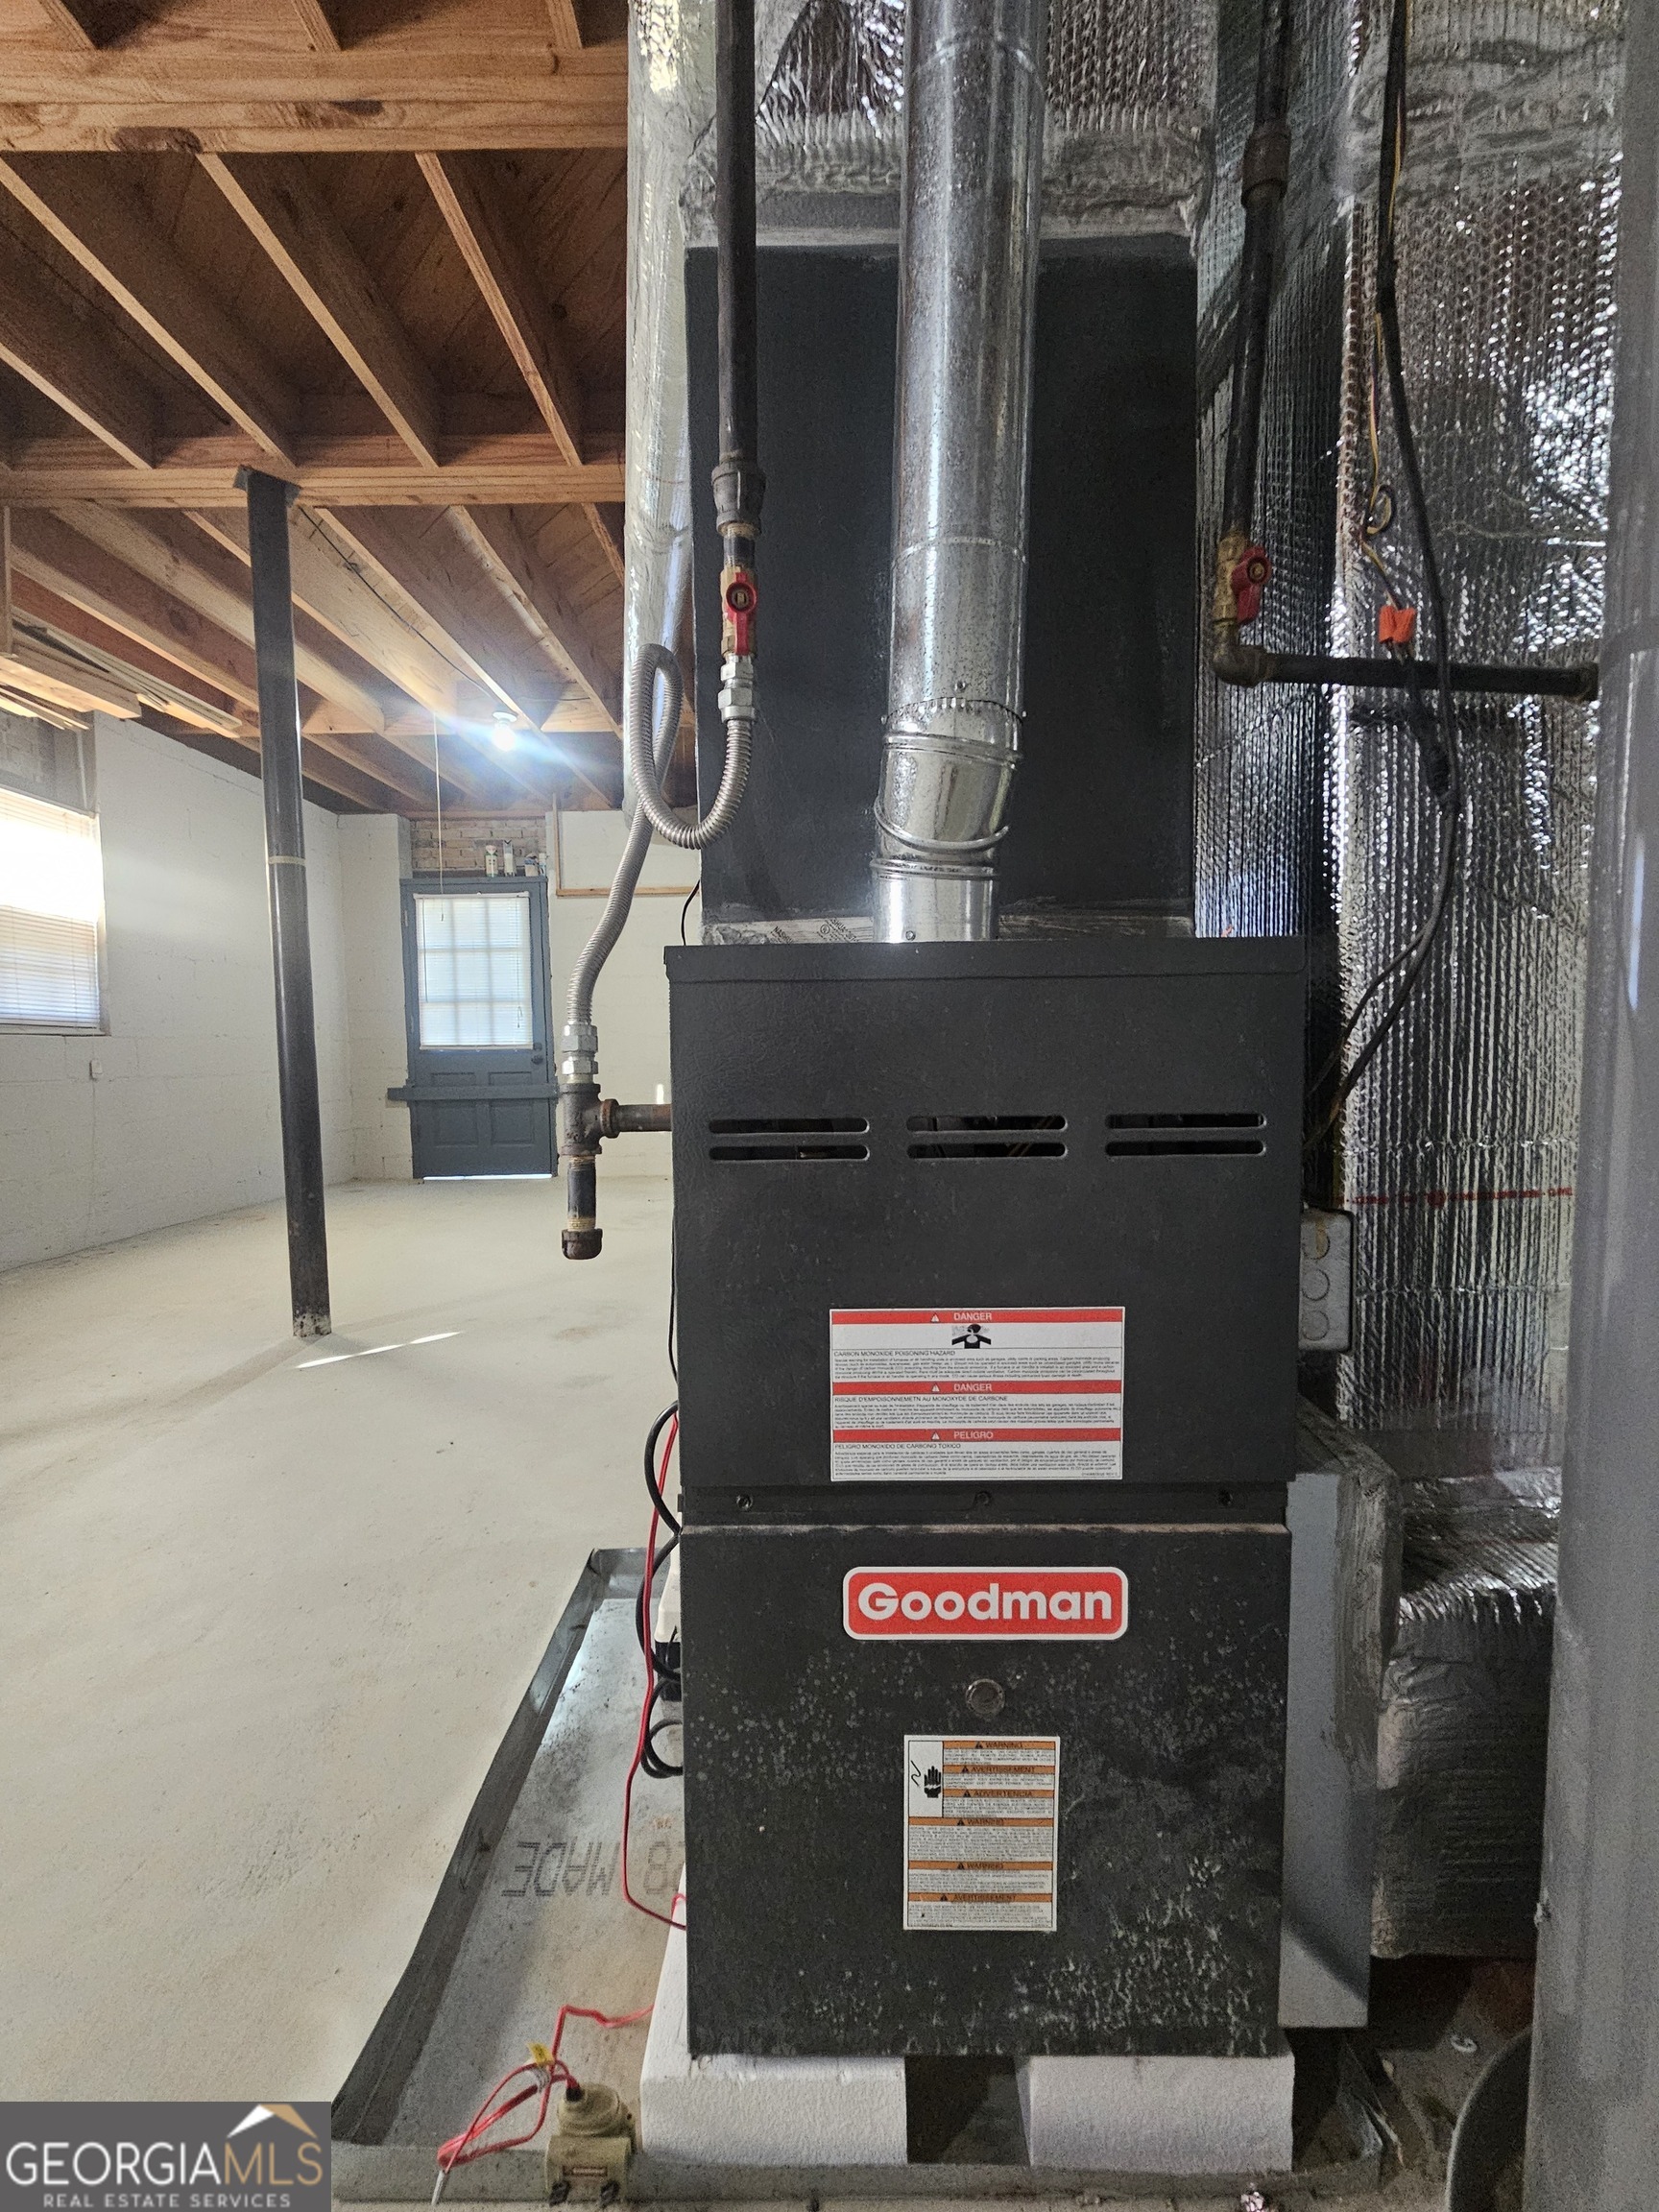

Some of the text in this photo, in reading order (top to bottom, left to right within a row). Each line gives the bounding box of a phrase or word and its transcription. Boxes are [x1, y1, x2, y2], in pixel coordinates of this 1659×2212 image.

[953, 1311, 993, 1321] DANGER
[953, 1383, 993, 1392] DANGER
[953, 1431, 994, 1440] PELIGRO
[857, 1582, 1112, 1621] Goodman
[500, 1838, 620, 1897] MADE
